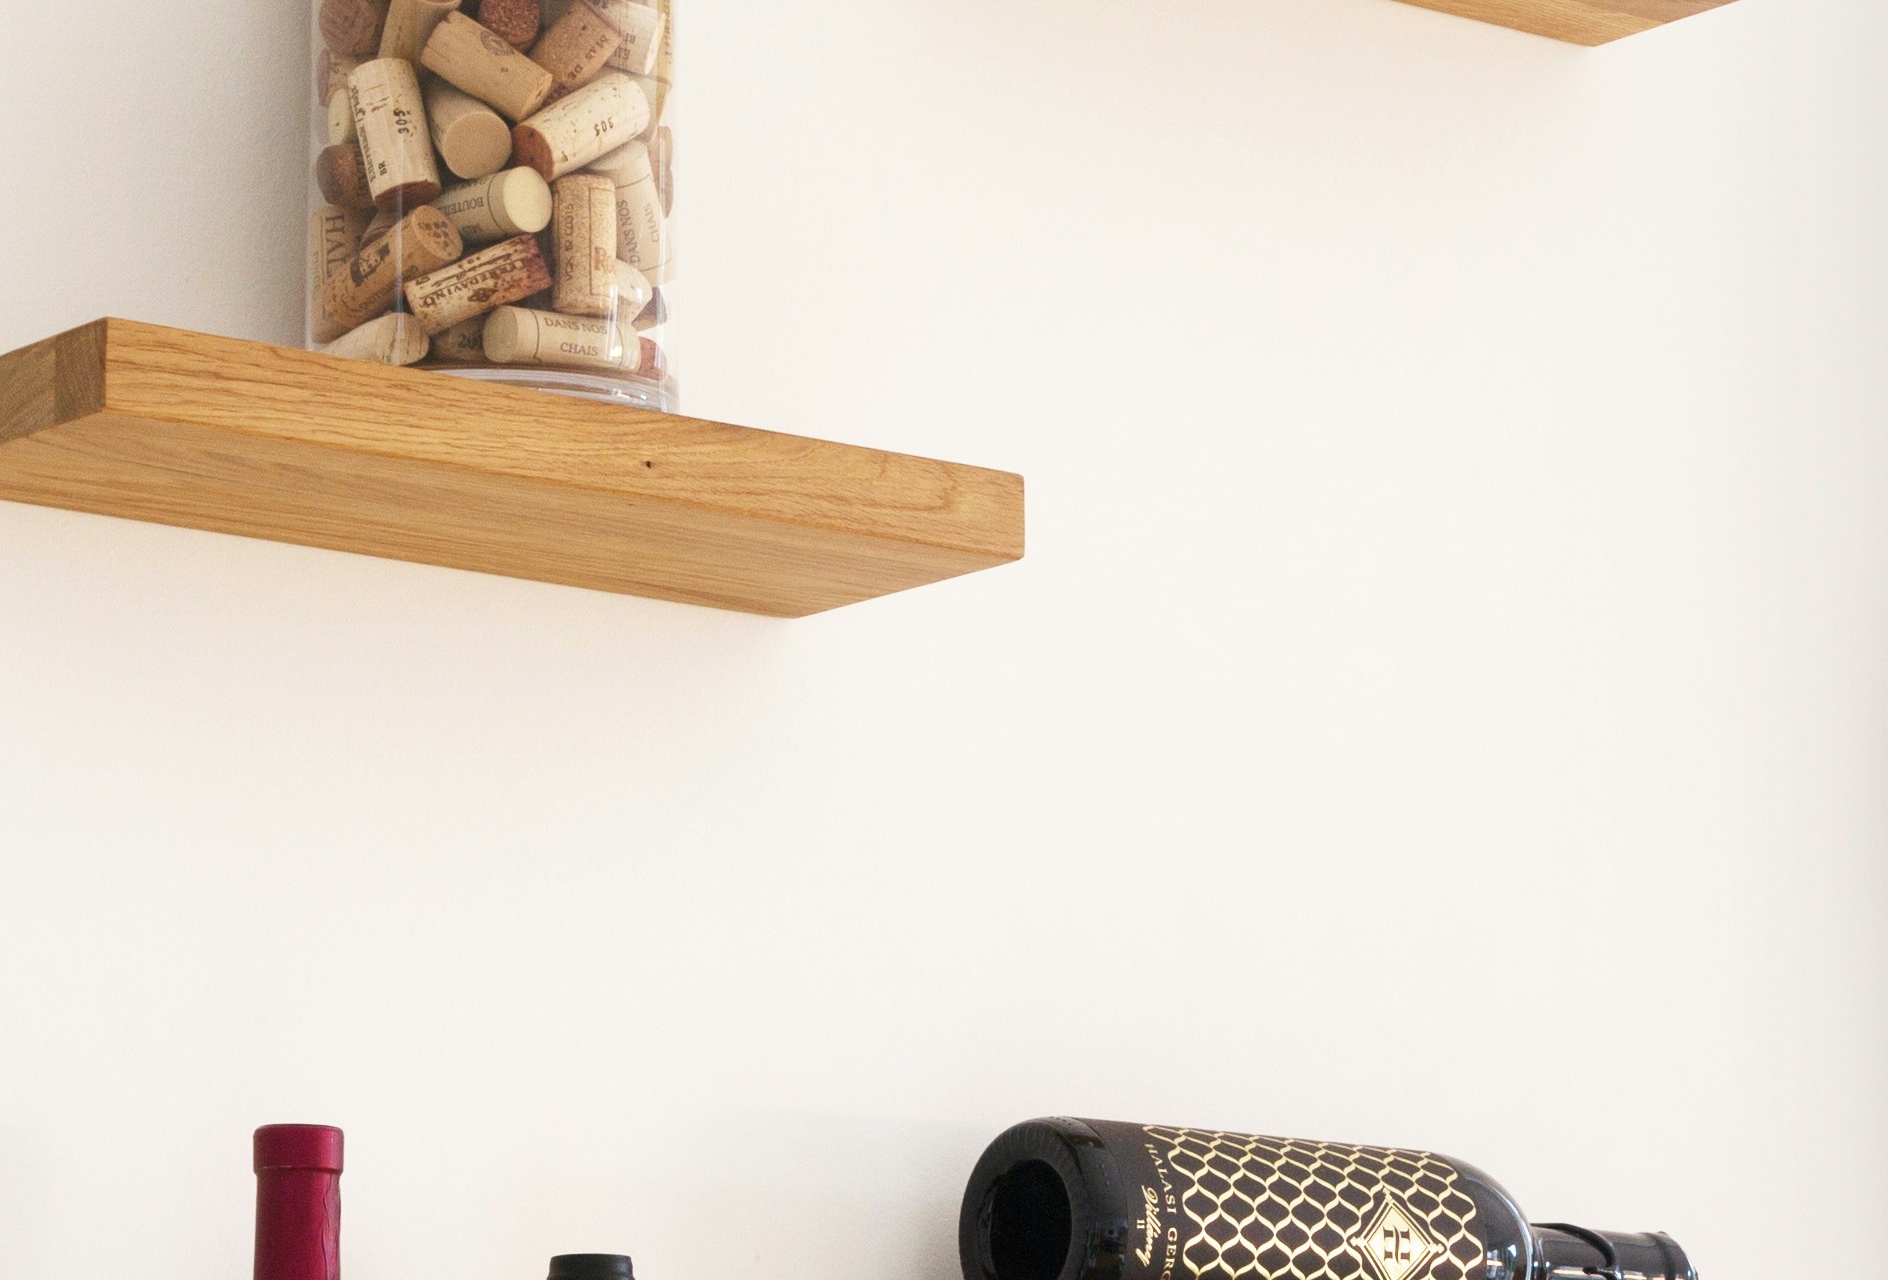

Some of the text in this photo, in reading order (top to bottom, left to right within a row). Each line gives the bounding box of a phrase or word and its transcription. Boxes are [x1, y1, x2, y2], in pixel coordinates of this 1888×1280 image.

[393, 107, 410, 135] 305
[594, 117, 614, 137] 305
[616, 199, 641, 264] DANS NOS
[643, 202, 659, 244] CHAIS
[544, 317, 608, 335] DANS NOS
[559, 341, 598, 357] CHAIS
[1144, 1142, 1177, 1215] HALASI
